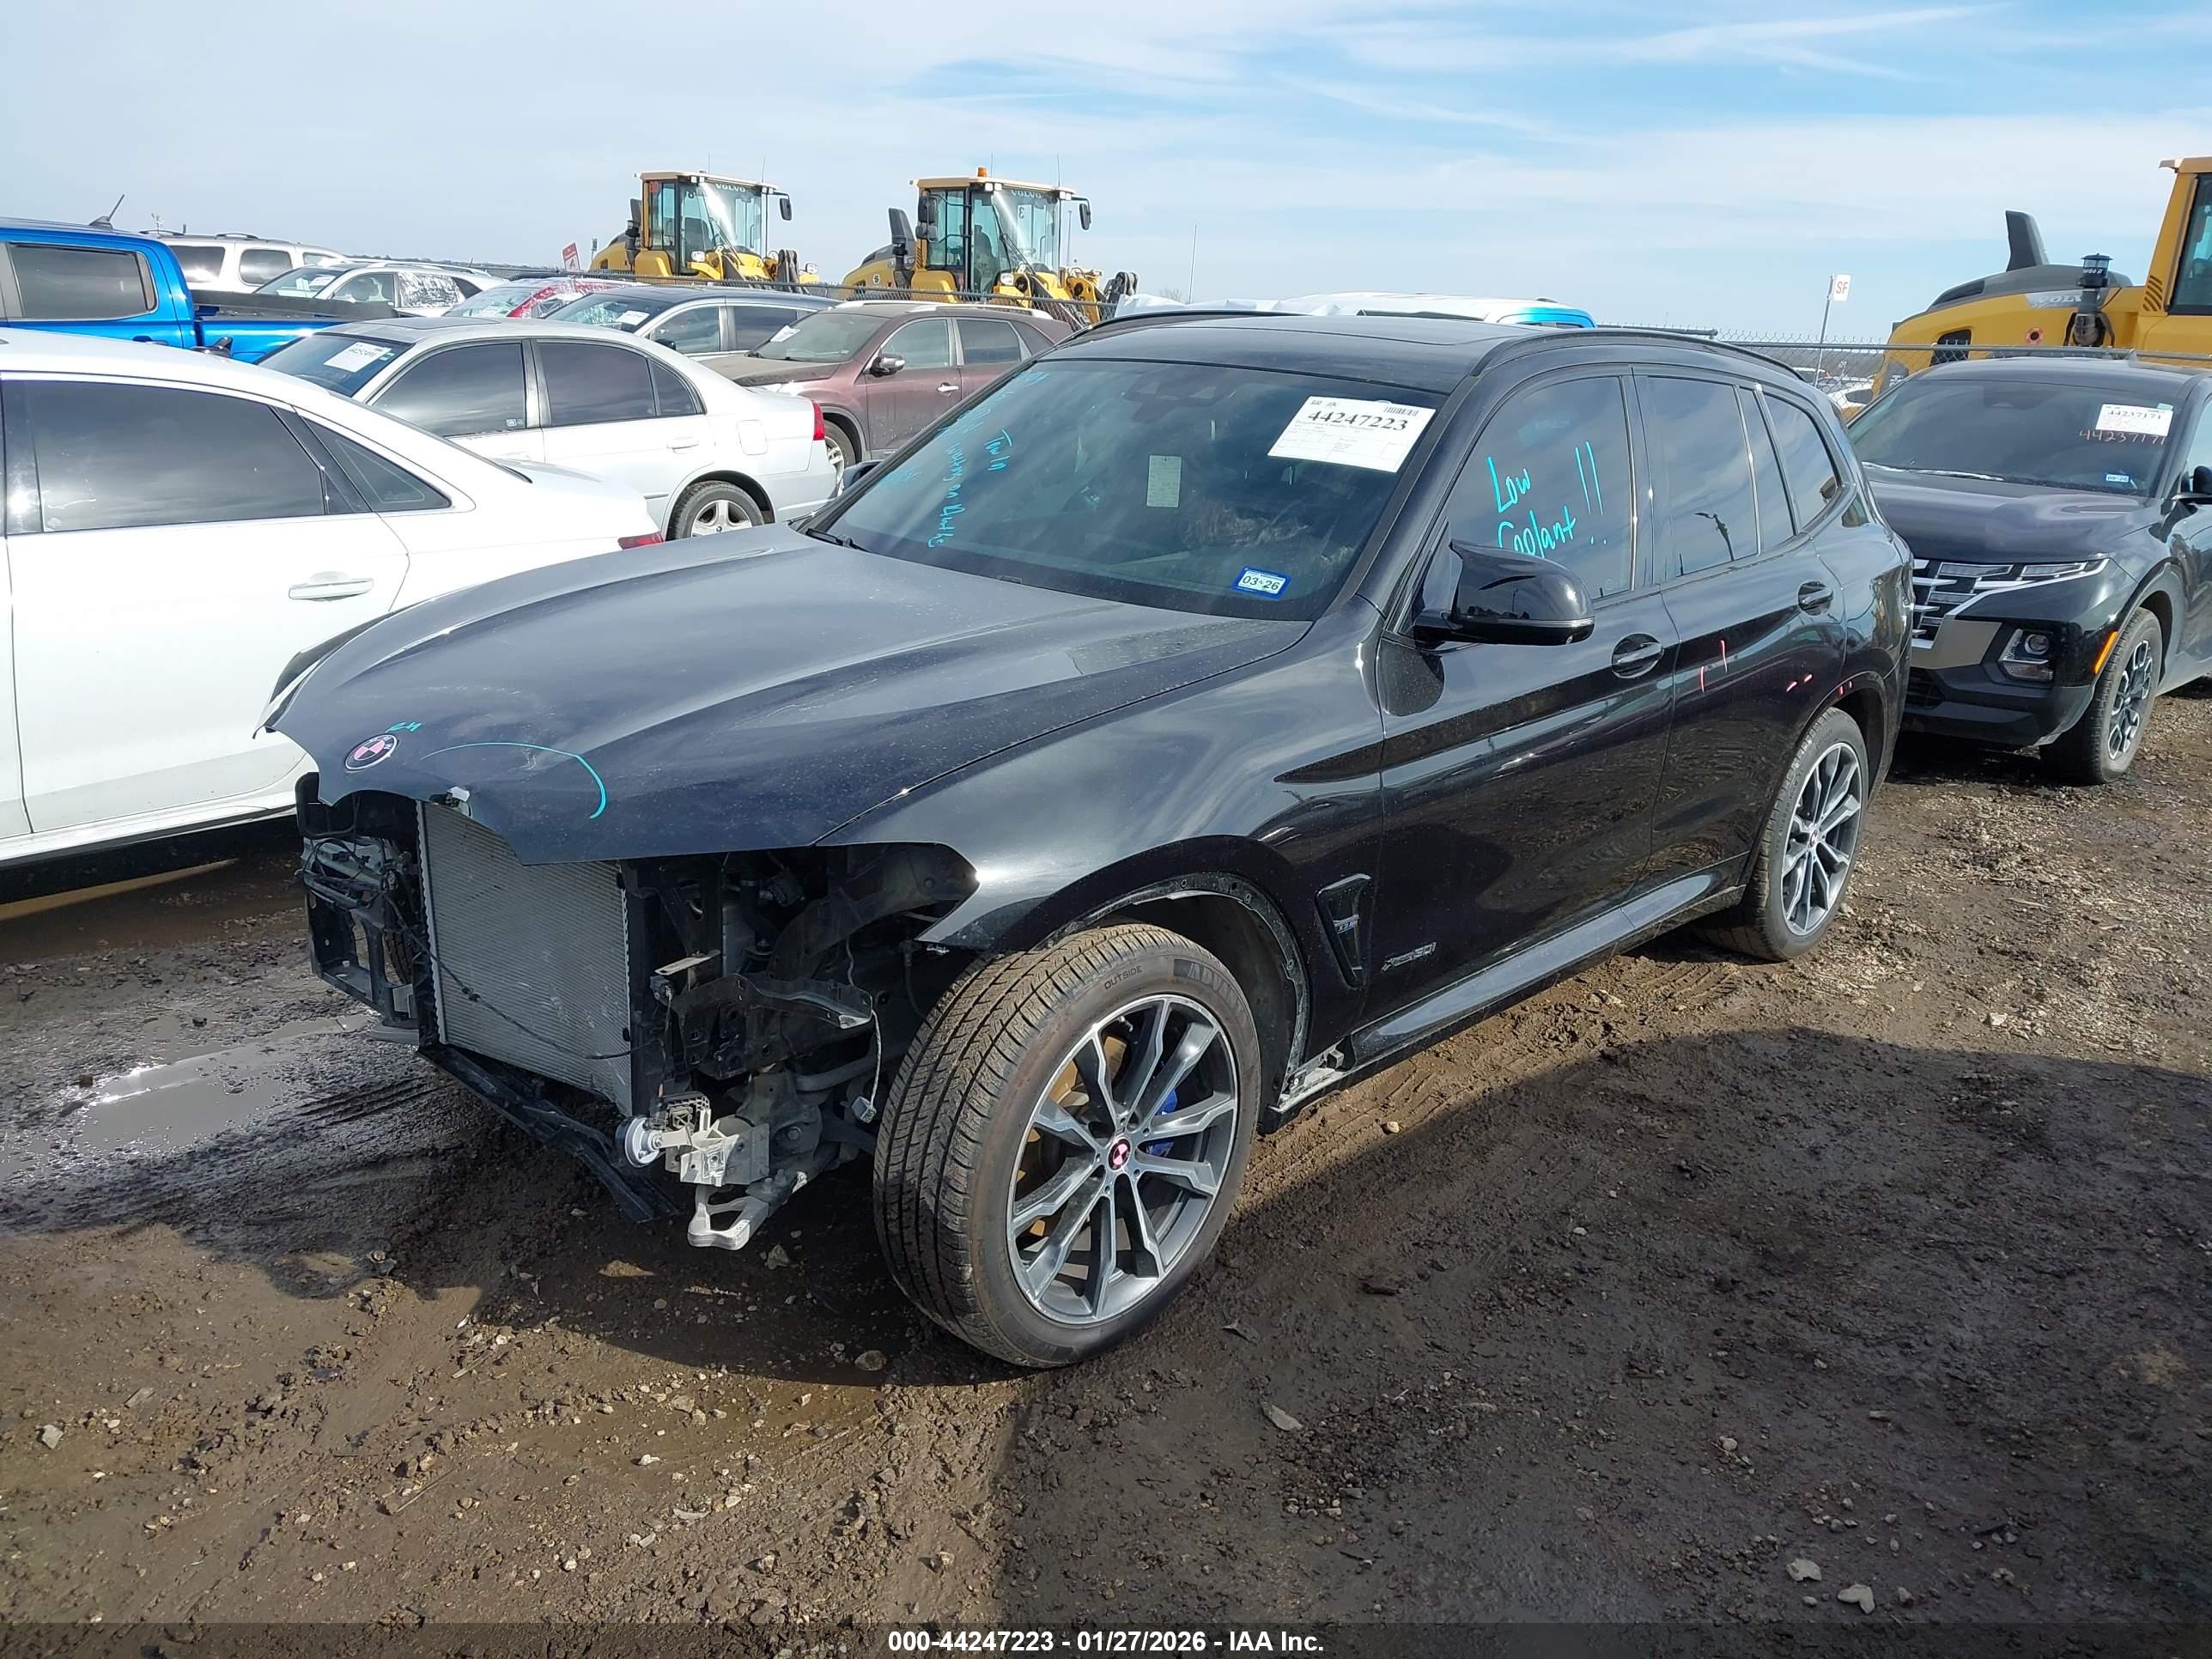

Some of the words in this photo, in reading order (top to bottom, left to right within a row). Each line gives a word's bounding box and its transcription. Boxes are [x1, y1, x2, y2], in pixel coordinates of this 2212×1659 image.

[714, 183, 746, 193] VOLVO
[1011, 189, 1042, 199] VOLVO
[1307, 410, 1409, 431] 44247223
[2107, 409, 2161, 420] 44237171
[2079, 429, 2166, 446] 44237171
[1487, 456, 1532, 514] Low
[1498, 505, 1577, 559] Coolant
[1103, 965, 1143, 990] OUTSIDE
